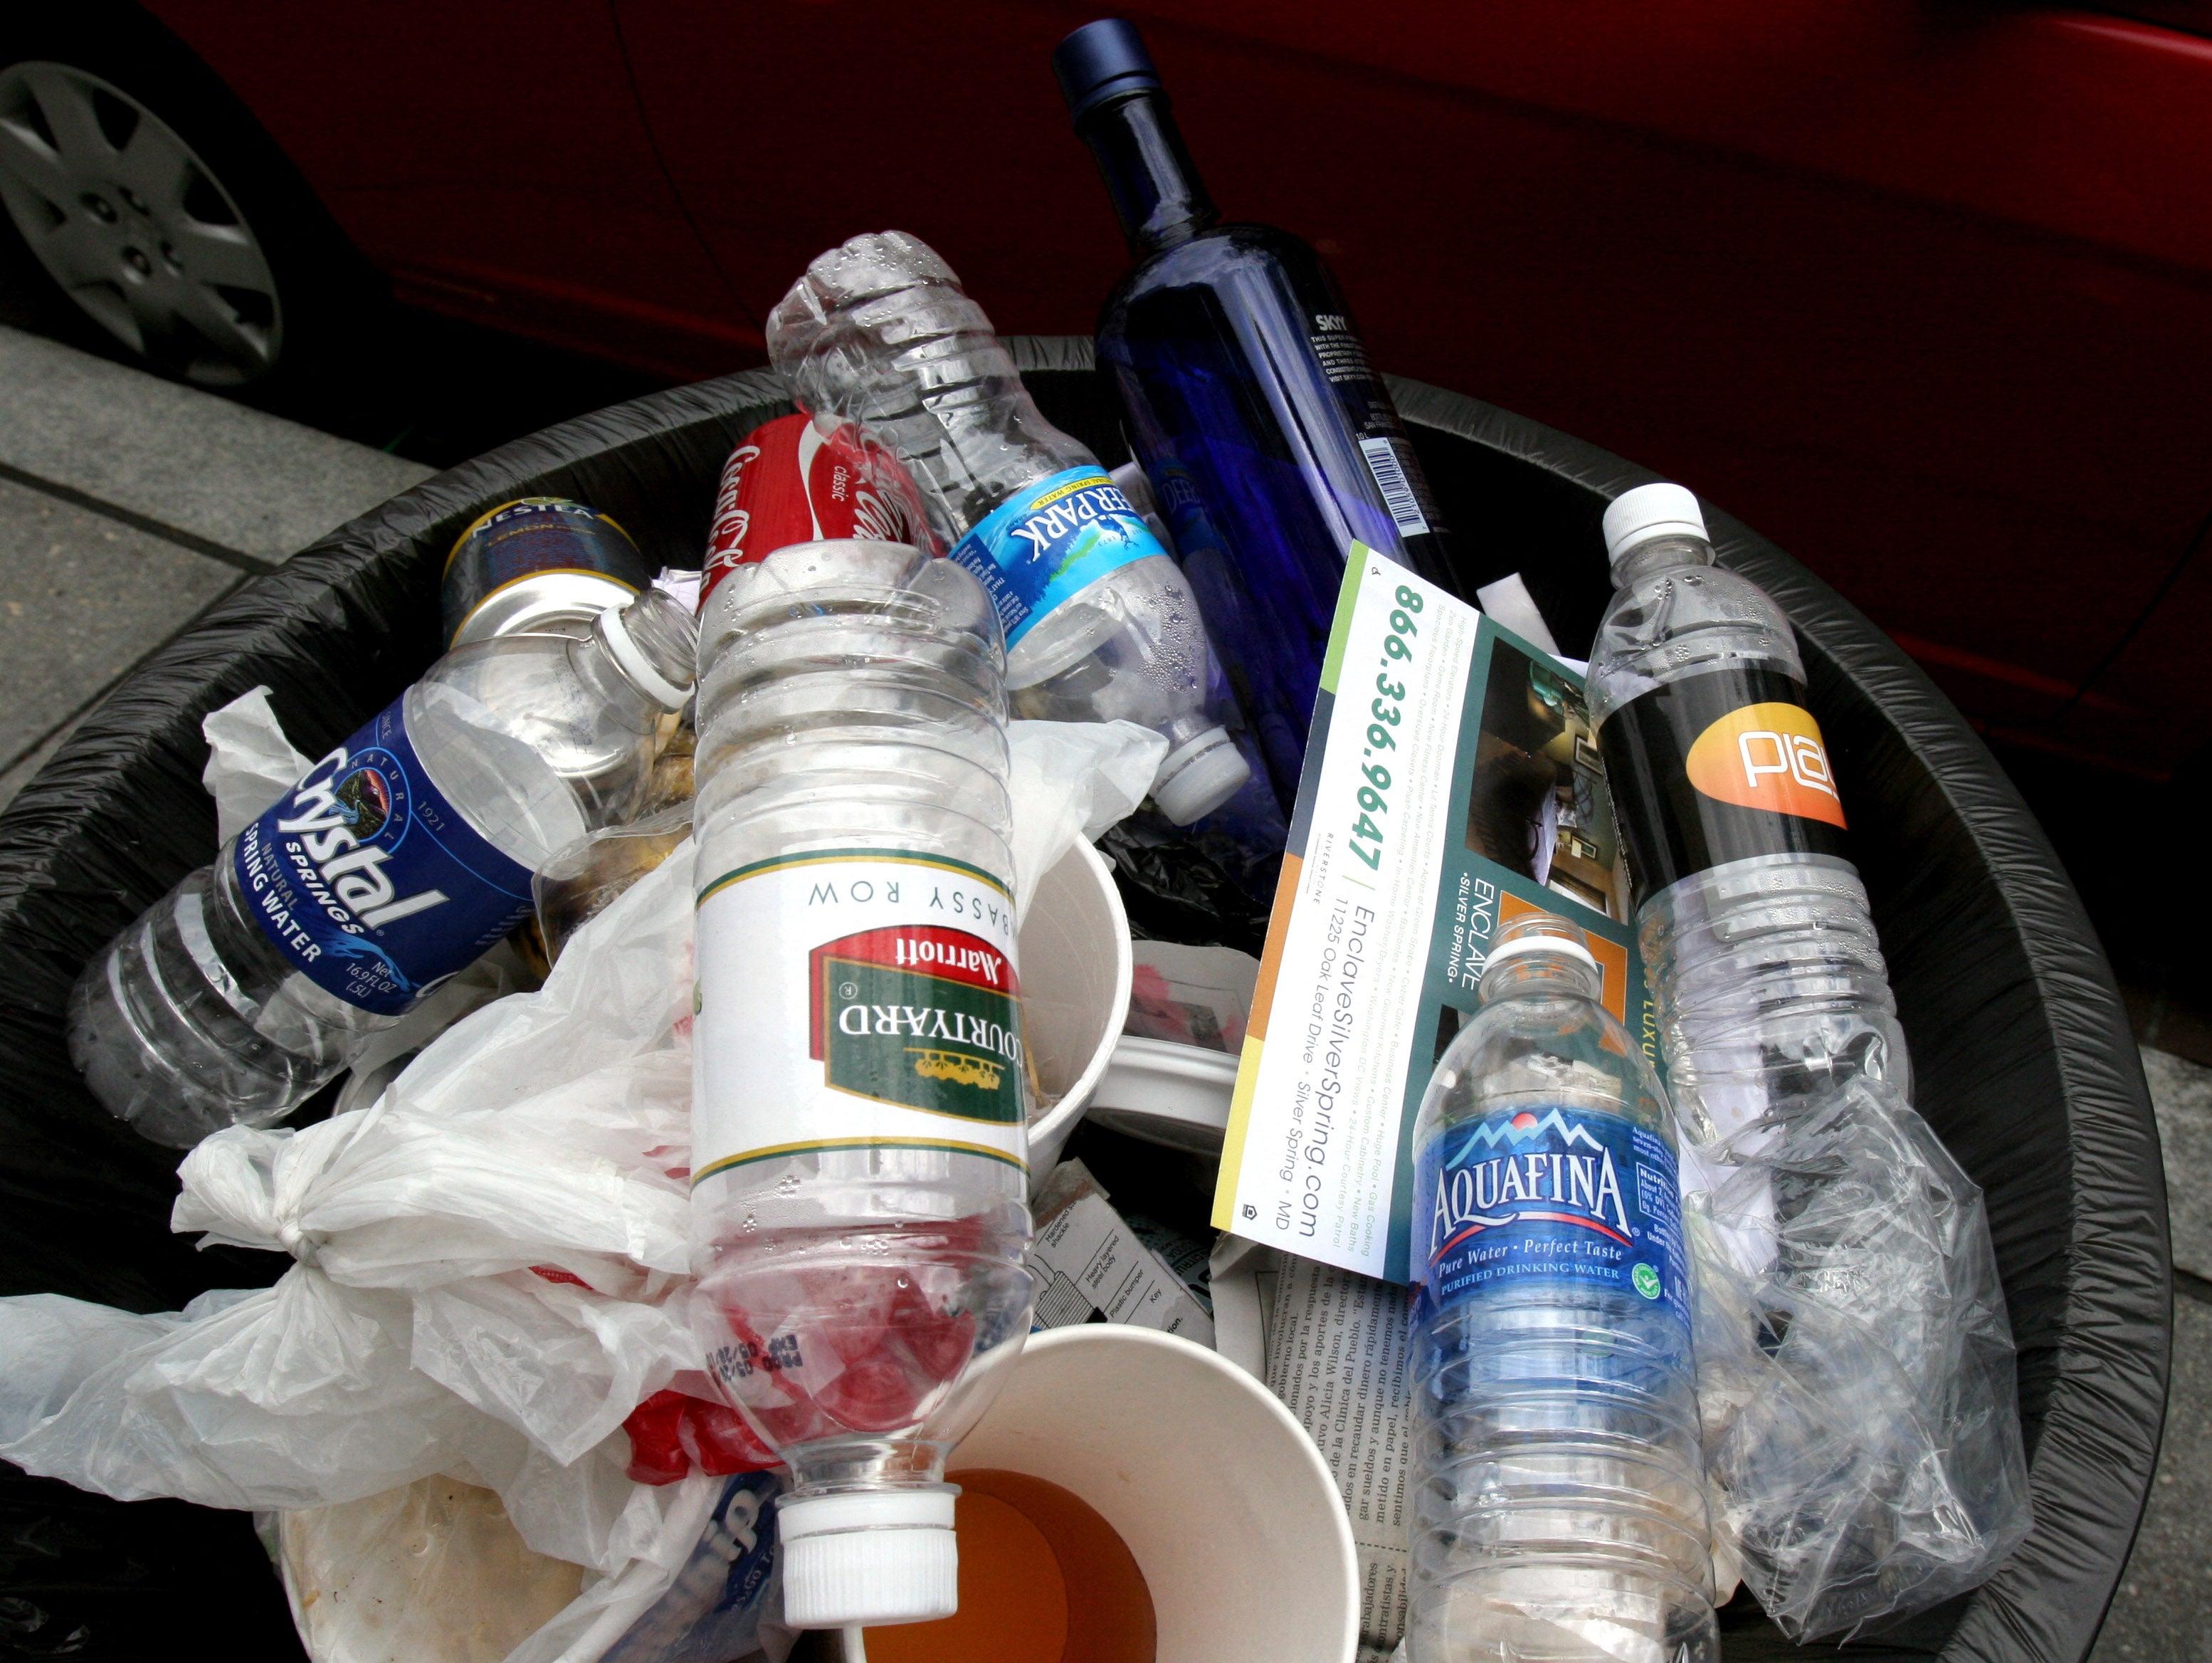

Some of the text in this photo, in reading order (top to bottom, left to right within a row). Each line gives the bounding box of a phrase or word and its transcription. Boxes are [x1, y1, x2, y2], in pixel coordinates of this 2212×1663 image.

[1316, 315, 1347, 331] SKYY
[832, 466, 850, 501] classic
[1038, 487, 1064, 506] WATER
[472, 504, 594, 538] NESTEA
[1011, 489, 1102, 562] PARK
[1348, 584, 1424, 871] 866.336.9647
[278, 746, 451, 931] Crystal
[418, 802, 446, 832] 1921
[244, 822, 322, 963] SPRING WATER
[260, 843, 297, 911] NATURAL
[286, 841, 365, 935] SPRINGS
[1315, 833, 1334, 903] RIVERSTONE
[809, 881, 1016, 937] BASSY ROW
[1466, 878, 1494, 992] ENCLAVE
[895, 938, 1002, 985] Marriott
[1273, 895, 1348, 1231] 11225 Oak Leaf Drive Silver Spring MD
[1299, 904, 1375, 1239] EnclaveSilverSpring.com
[1045, 1209, 1070, 1243] Hardened
[1428, 1146, 1632, 1261] AQUAFINA
[1051, 1222, 1070, 1248] shackle
[1085, 1234, 1120, 1283] Heavy layered
[1438, 1239, 1623, 1279] Pure Water Perfect Taste
[1102, 1254, 1117, 1275] body
[1441, 1263, 1619, 1295] PURIFIED DRINKING WATER
[1109, 1269, 1145, 1318] Plastic bumper
[1149, 1287, 1162, 1304] Key
[1363, 1281, 1384, 1357] rápidamente
[1386, 1564, 1396, 1573] y
